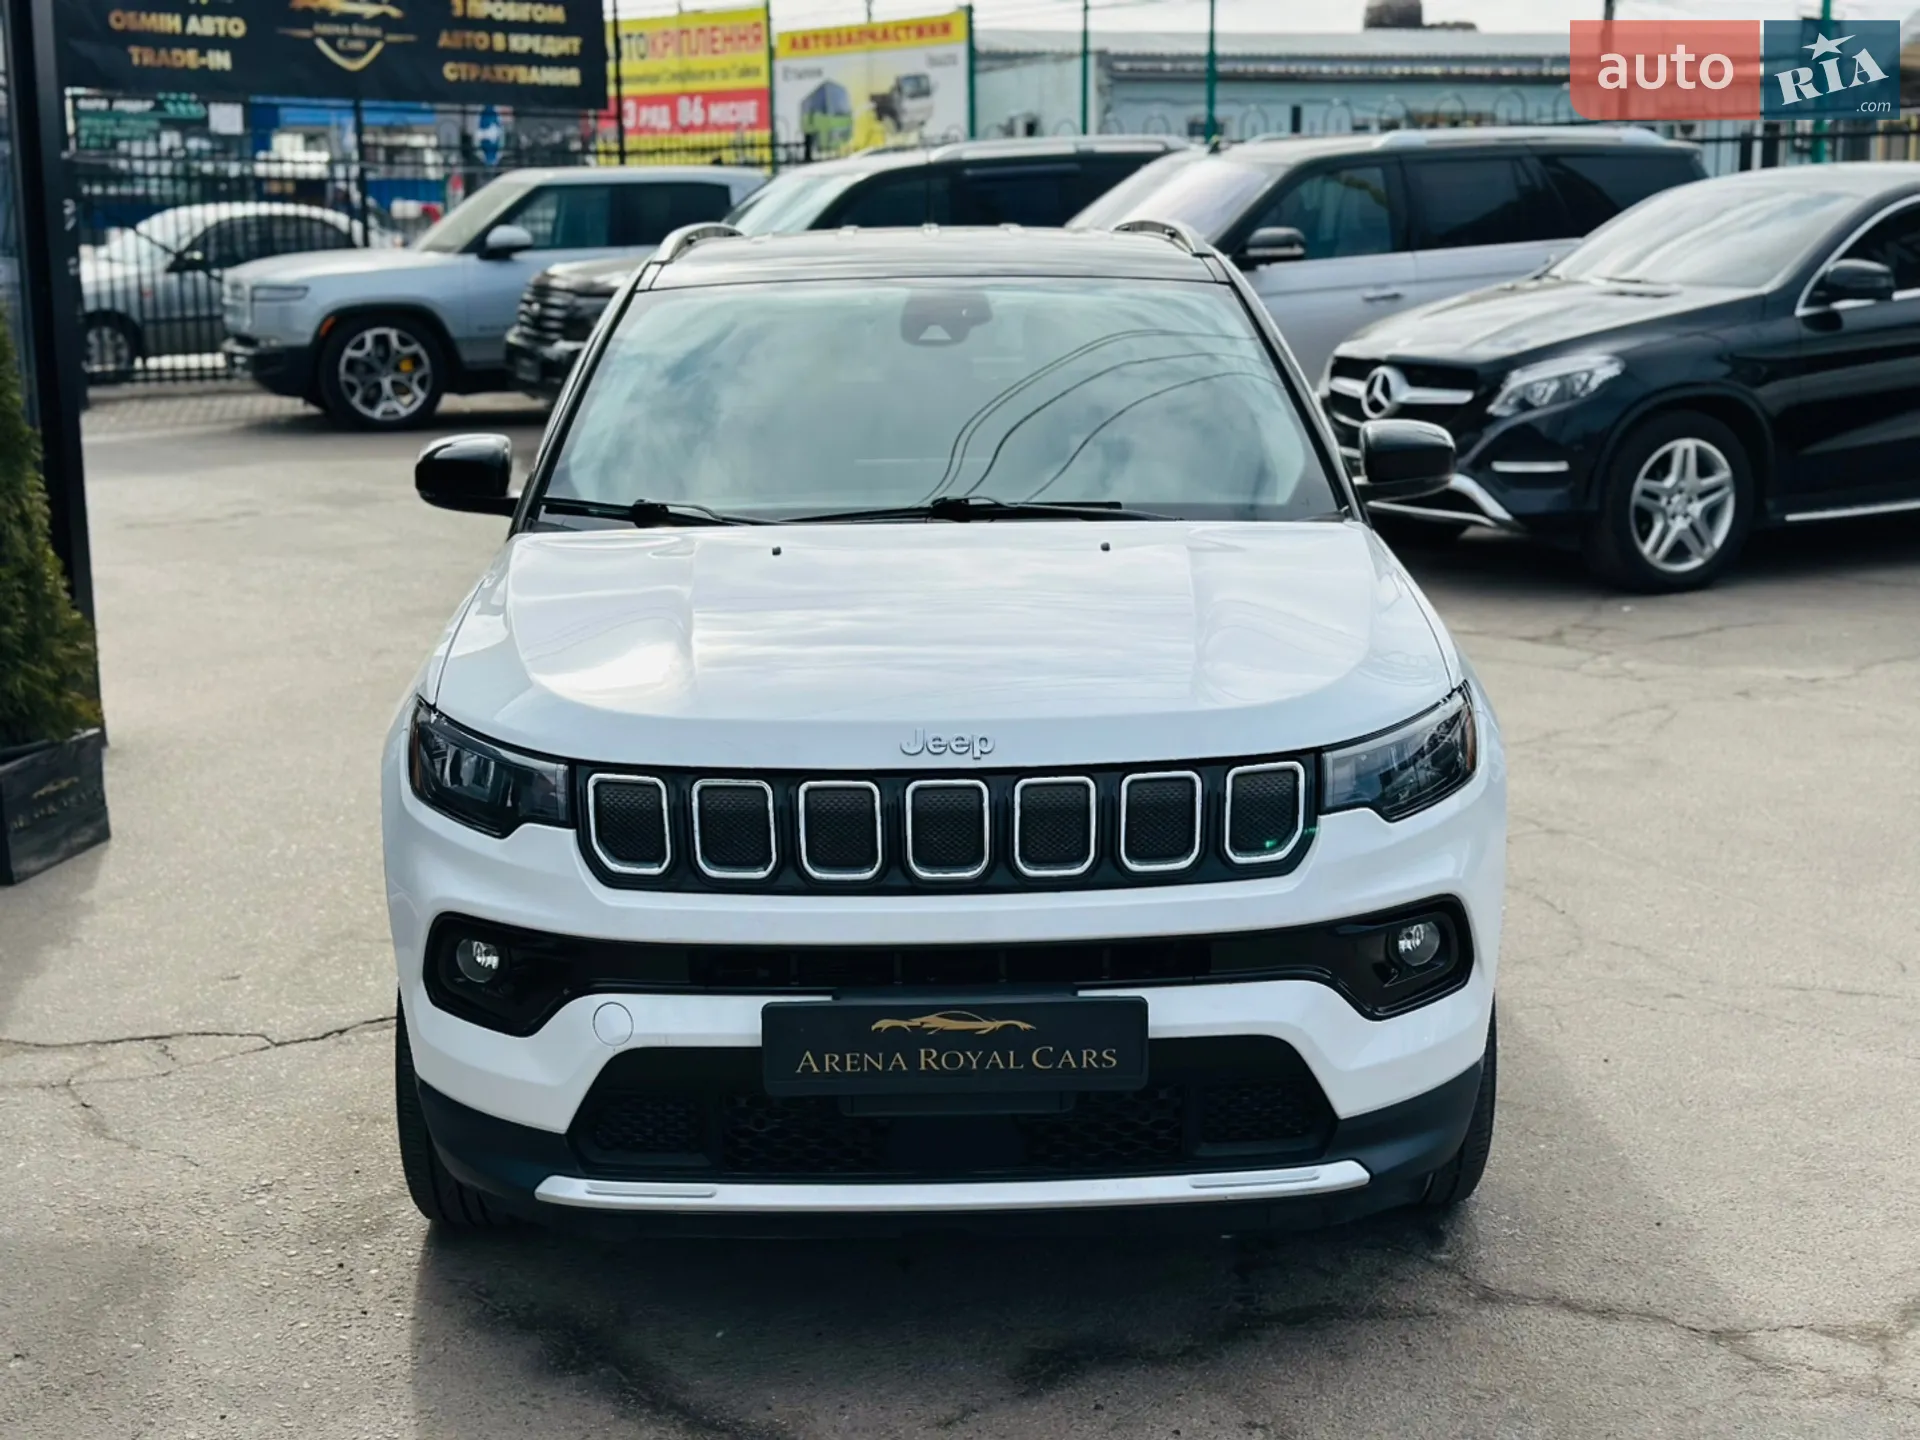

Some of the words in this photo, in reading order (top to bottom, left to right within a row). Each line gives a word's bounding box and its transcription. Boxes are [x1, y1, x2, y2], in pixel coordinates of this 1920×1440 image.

[108, 9, 183, 34] ОБМІН
[185, 14, 247, 38] АВТО
[437, 29, 490, 50] АВТО
[492, 32, 506, 52] В
[508, 32, 582, 57] КРЕДИТ
[128, 45, 232, 71] TRADE-IN
[900, 727, 995, 760] Jeep
